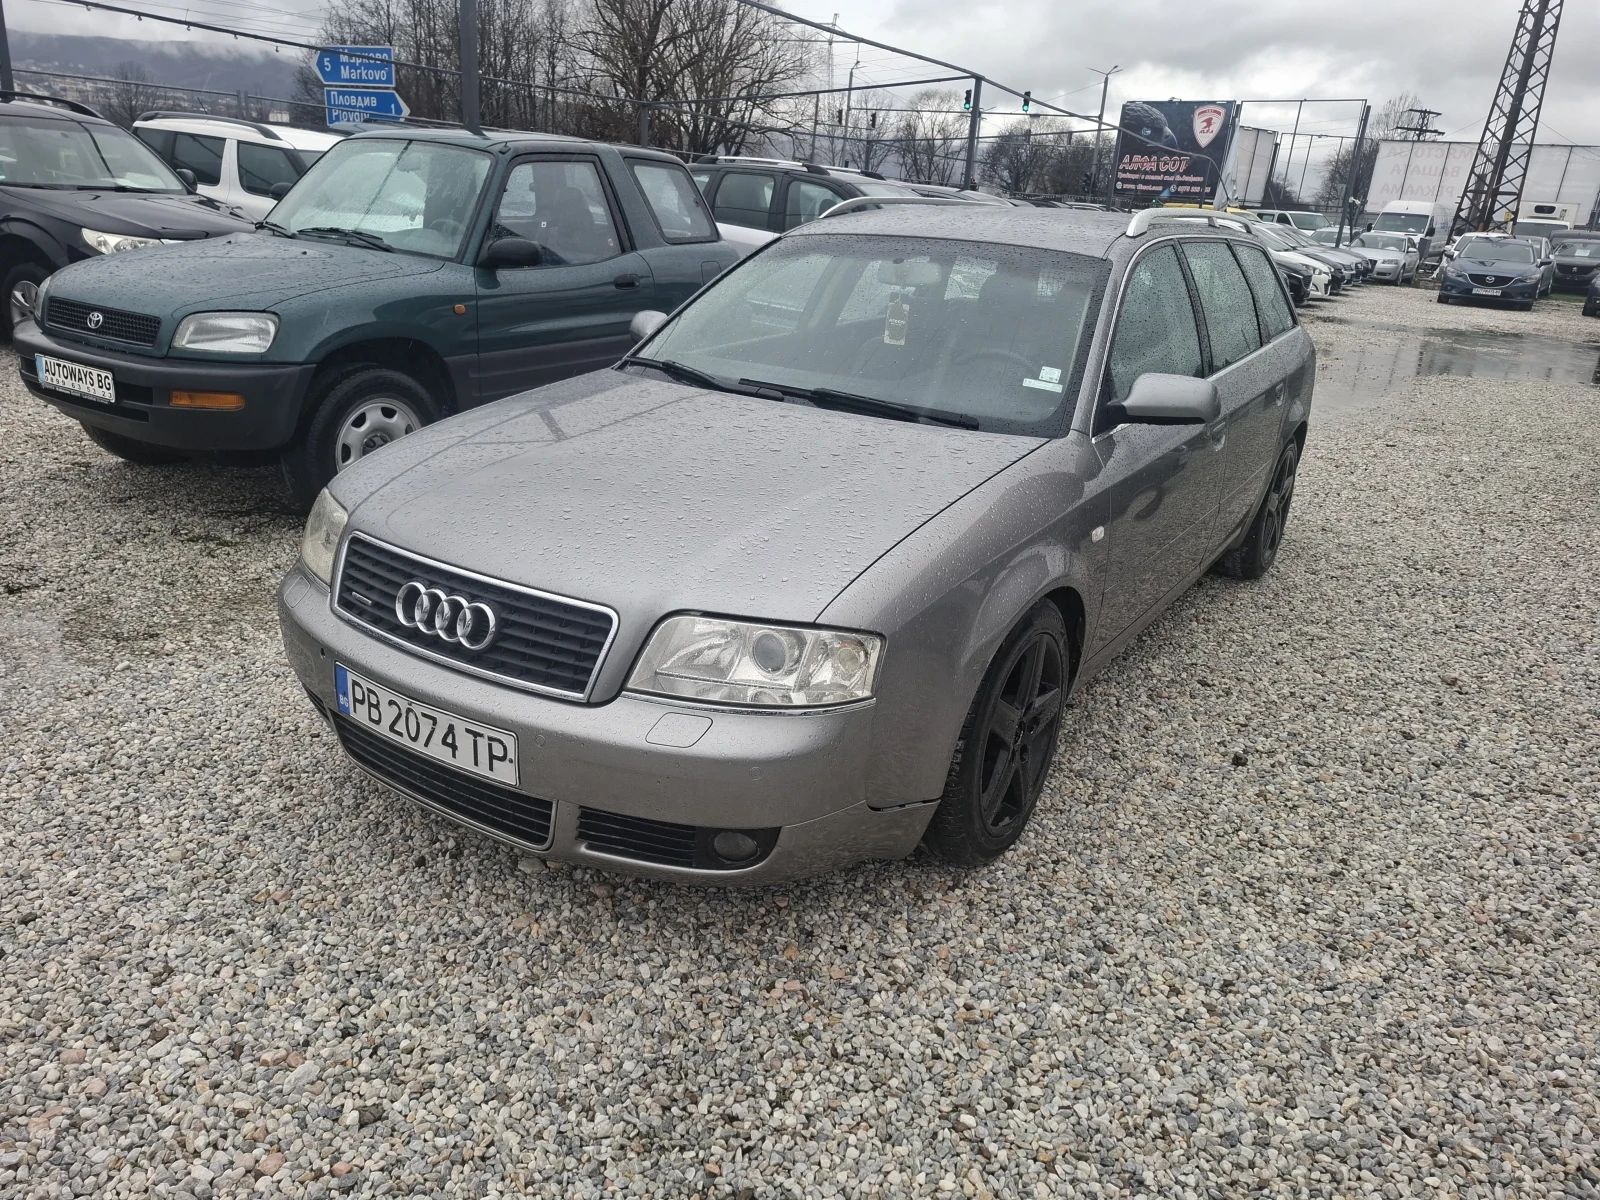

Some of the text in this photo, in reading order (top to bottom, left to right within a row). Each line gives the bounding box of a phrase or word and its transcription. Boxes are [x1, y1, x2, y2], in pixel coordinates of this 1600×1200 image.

[323, 57, 332, 72] 5
[340, 65, 387, 81] Markovo
[330, 91, 377, 108] Пловдив
[390, 103, 396, 115] 1
[1119, 154, 1190, 172] АЛФА СОТ
[44, 359, 112, 391] AUTOWAYS BG
[44, 375, 66, 386] 0899
[71, 382, 82, 391] 63
[86, 386, 97, 395] 53
[101, 390, 112, 399] 23
[339, 693, 349, 708] BG
[352, 678, 508, 772] PB 2074 TP
